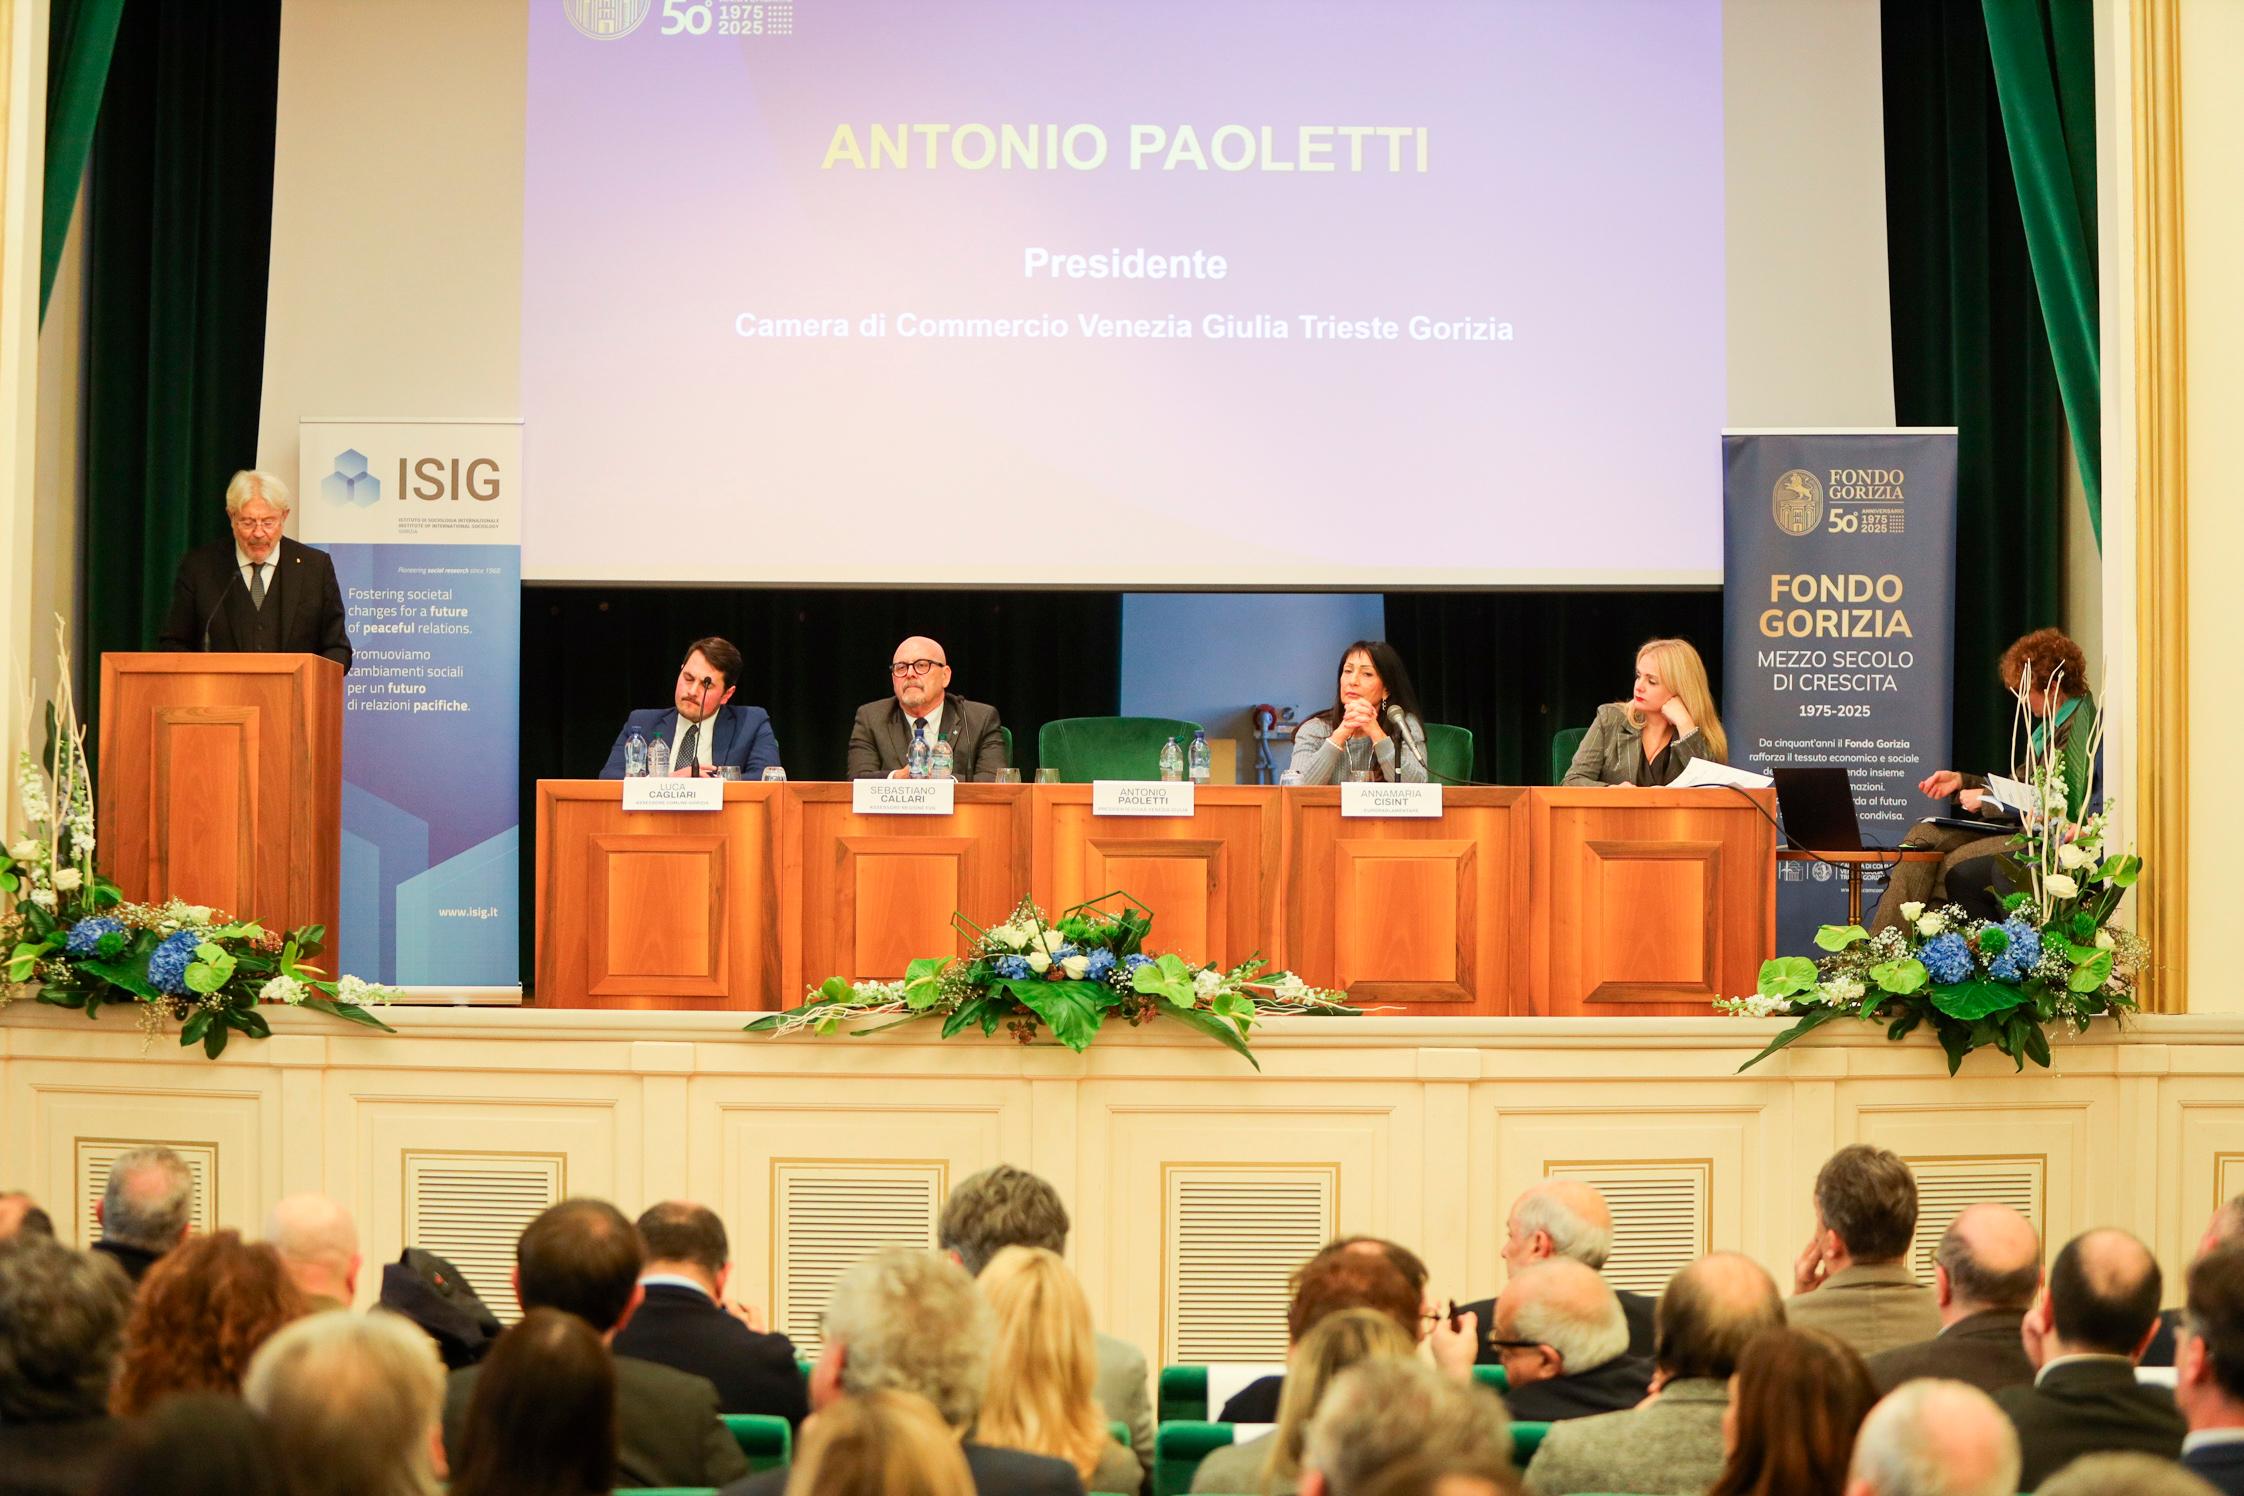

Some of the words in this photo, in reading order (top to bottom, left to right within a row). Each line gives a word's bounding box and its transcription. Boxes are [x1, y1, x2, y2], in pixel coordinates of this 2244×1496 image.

[719, 5, 764, 20] 1975
[718, 20, 764, 35] 2025
[821, 122, 1108, 171] ANTONIO
[1130, 124, 1428, 173] PAOLETTI
[1024, 247, 1228, 279] Presidente
[735, 312, 849, 338] Camera
[859, 312, 886, 338] di
[896, 312, 1069, 338] Commercio
[1077, 313, 1193, 339] Venezia
[1202, 313, 1289, 339] Giulia
[1298, 314, 1400, 340] Trieste
[1408, 315, 1514, 341] Gorizia
[398, 457, 501, 501] ISIG
[1829, 469, 1904, 485] FONDO
[1829, 485, 1904, 500] GORIZIA
[1861, 515, 1888, 524] 1975
[1861, 524, 1888, 533] 2025
[348, 587, 405, 602] Fostering
[407, 588, 453, 600] societal
[1770, 574, 1904, 603] FONDO
[348, 604, 397, 619] changes
[400, 604, 417, 617] for
[419, 607, 427, 617] a
[429, 605, 468, 617] future
[348, 621, 360, 633] of
[363, 622, 415, 636] peaceful
[418, 622, 473, 634] relations.
[1759, 609, 1913, 638] GORIZIA
[1758, 650, 1827, 668] MEZZO
[1832, 650, 1914, 668] SECOLO
[348, 665, 424, 677] cambiamenti
[427, 665, 464, 678] sociali
[1773, 674, 1793, 691] DI
[1799, 673, 1898, 691] CRESCITA
[347, 683, 367, 696] per
[370, 684, 385, 694] un
[387, 682, 426, 694] futuro
[347, 699, 358, 711] di
[361, 699, 411, 711] relazioni
[413, 699, 471, 713] pacifiche.
[1799, 704, 1871, 717] 1975-2025
[1759, 738, 1773, 748] Da
[1838, 738, 1843, 748] il
[1844, 739, 1873, 748] Fondo
[1876, 739, 1910, 749] Gorizia
[1749, 752, 1786, 762] rafforza
[1787, 753, 1793, 762] il
[1794, 753, 1828, 762] tessuto
[1829, 753, 1878, 763] economico
[1879, 755, 1886, 763] e
[1887, 753, 1920, 763] sociale
[1869, 768, 1905, 777] insieme
[660, 783, 686, 791] LUCA
[870, 786, 936, 795] SEBASTIANO
[1120, 788, 1167, 797] ANTONIO
[1361, 789, 1422, 798] ANNAMARIA
[648, 791, 696, 799] CAGLIARI
[880, 794, 925, 803] CALLARI
[1118, 796, 1169, 805] PAOLETTI
[1868, 797, 1878, 806] al
[1879, 797, 1908, 806] futuro
[1374, 798, 1409, 806] CISINT
[1859, 811, 1905, 821] condivisa.
[438, 906, 498, 919] www.isig.it
